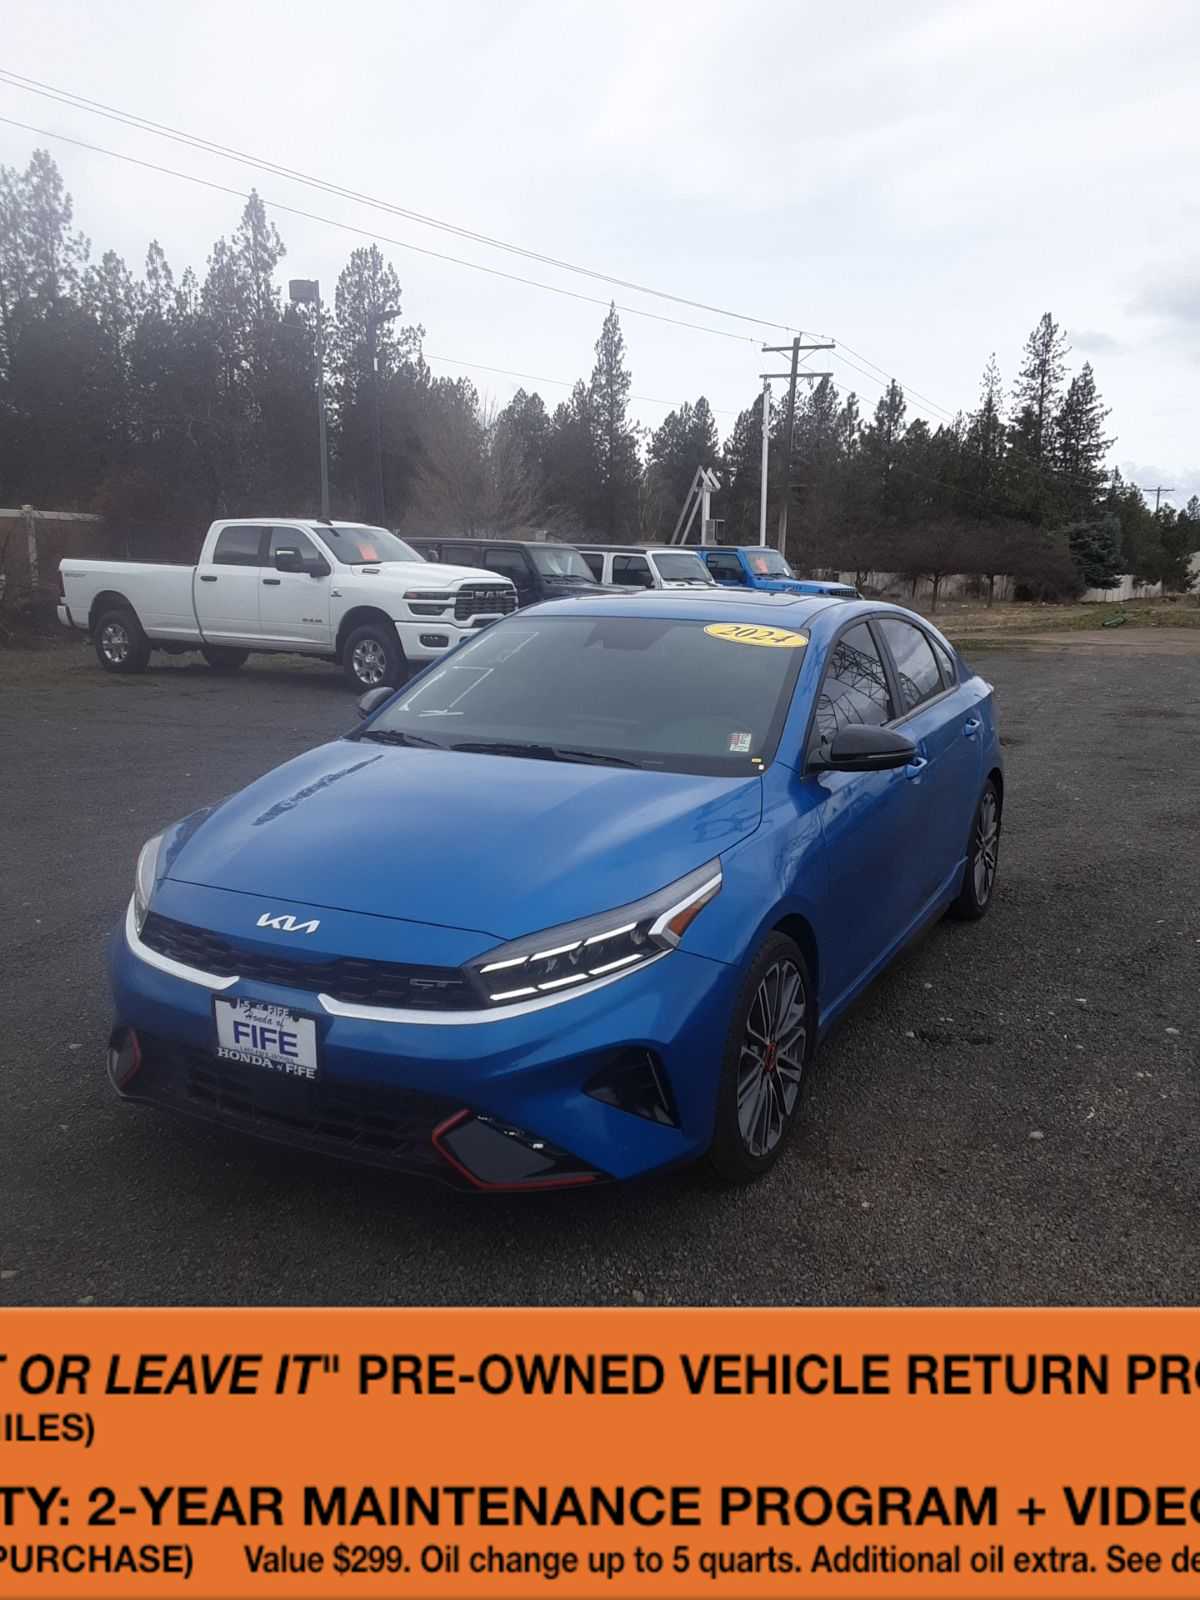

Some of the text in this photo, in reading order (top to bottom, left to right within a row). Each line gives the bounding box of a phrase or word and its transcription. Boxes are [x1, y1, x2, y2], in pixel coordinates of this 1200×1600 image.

[717, 626, 796, 643] 2024
[256, 912, 321, 934] KIA
[267, 1005, 289, 1017] FIFE
[233, 1020, 299, 1058] FIFE
[217, 1047, 274, 1069] HONDA
[285, 1063, 316, 1080] FIFE
